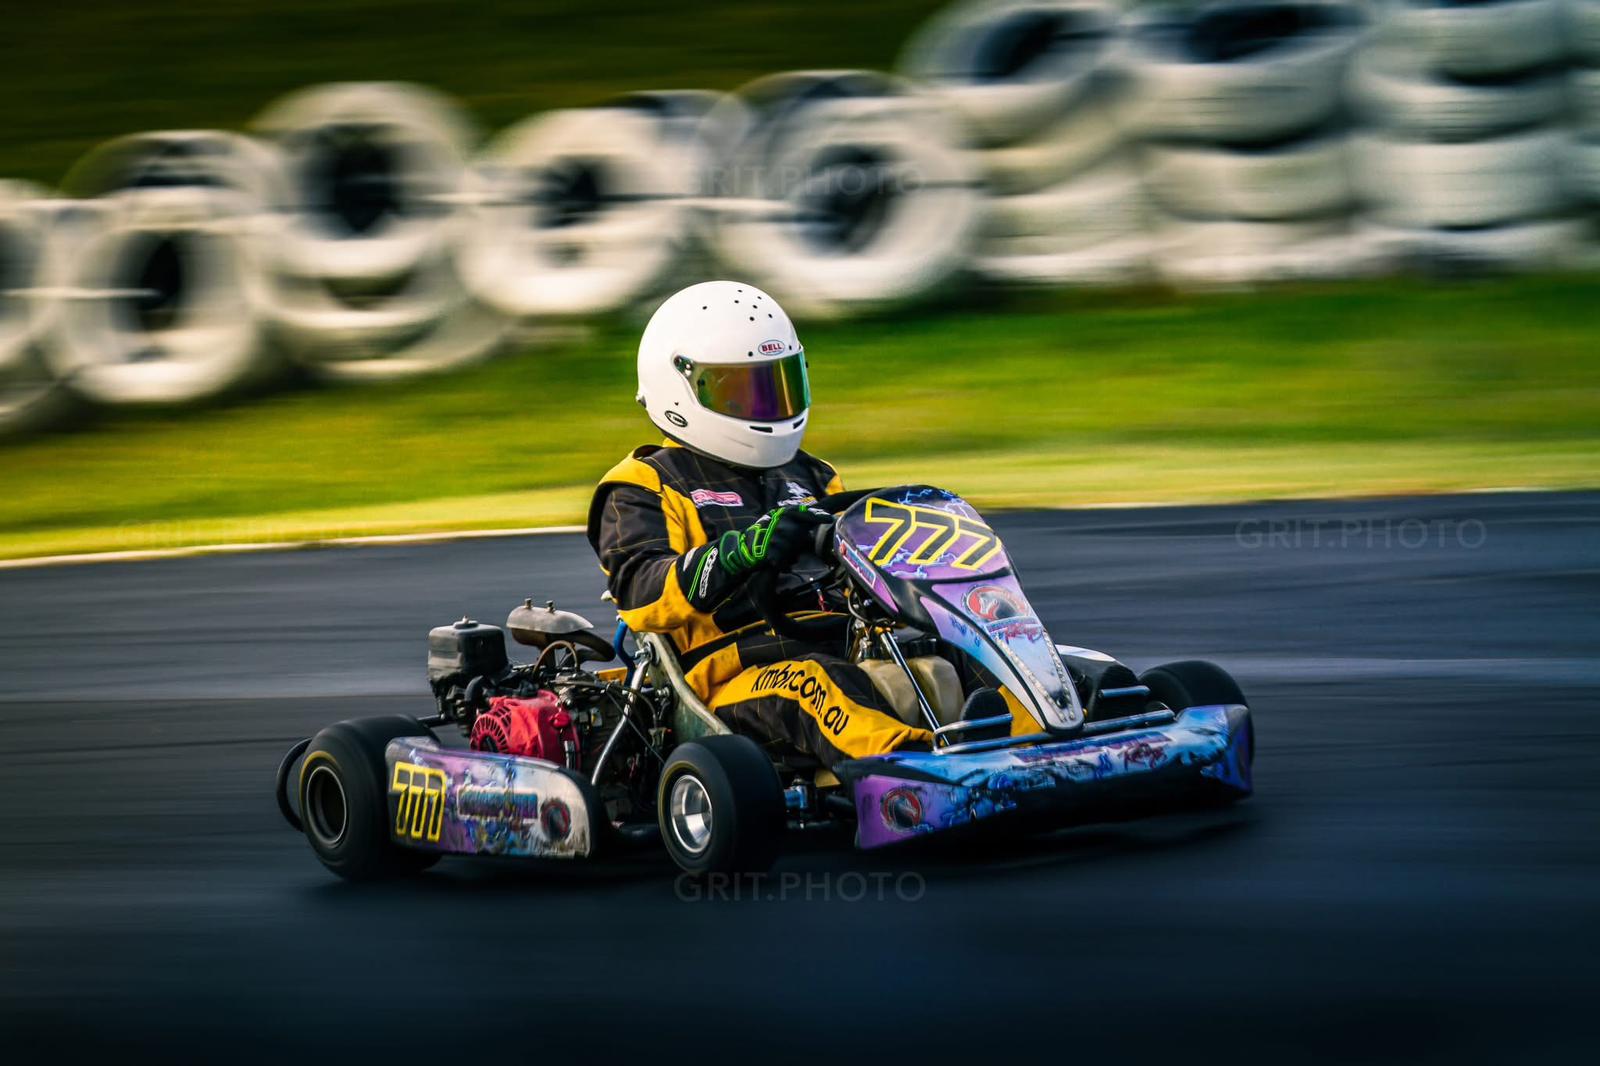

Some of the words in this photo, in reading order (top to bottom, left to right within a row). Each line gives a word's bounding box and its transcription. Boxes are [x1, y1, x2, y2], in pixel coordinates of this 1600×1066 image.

[762, 343, 783, 352] BELL
[864, 497, 1002, 571] 777
[392, 761, 447, 843] 777
